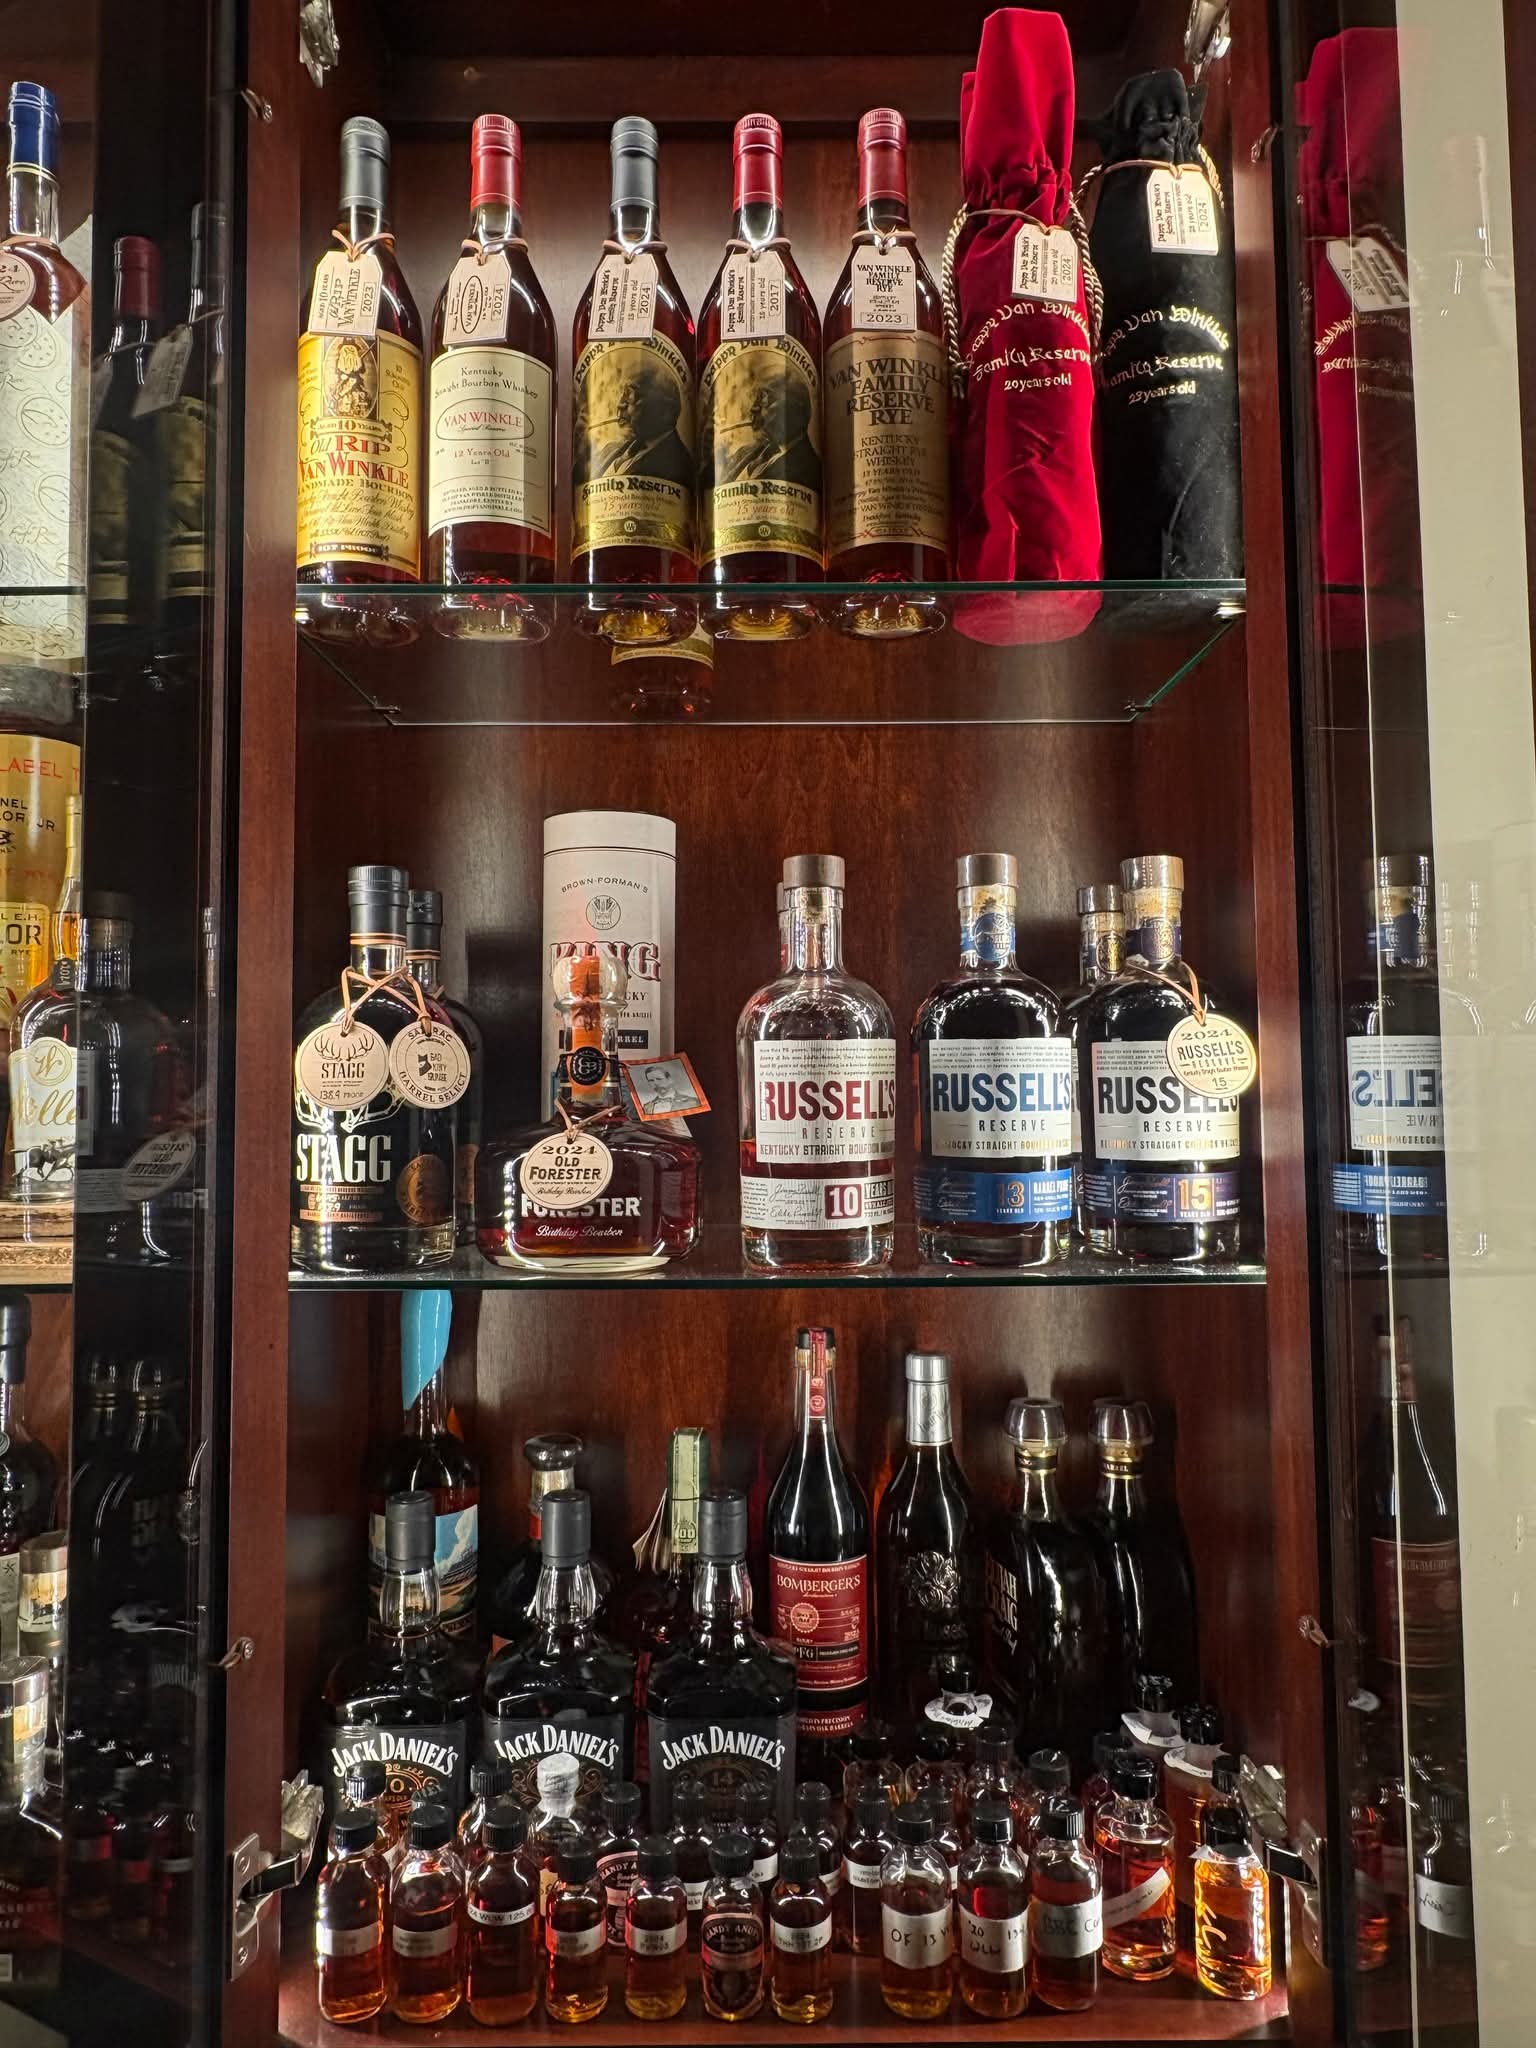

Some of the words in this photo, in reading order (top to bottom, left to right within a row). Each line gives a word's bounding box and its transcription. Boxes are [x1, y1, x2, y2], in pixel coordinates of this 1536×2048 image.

[876, 265, 912, 273] WINKLE
[363, 286, 379, 313] 2023
[493, 288, 505, 316] 2024
[640, 287, 651, 315] 2024
[770, 284, 780, 312] 2017
[867, 314, 903, 323] 2023
[997, 302, 1035, 320] Van
[461, 366, 503, 377] Kentucky
[1154, 354, 1224, 377] Reserve
[461, 377, 500, 388] Bourbon
[851, 375, 928, 395] FAMILY
[847, 391, 935, 416] RESERVE
[444, 412, 467, 427] VAN
[469, 411, 524, 427] WINKLE
[869, 409, 913, 426] RYE
[335, 435, 391, 456] RIP
[466, 448, 493, 456] Years
[494, 448, 511, 458] Old
[326, 452, 409, 491] WINKLE
[582, 479, 625, 501] Family
[627, 477, 681, 500] Reserve
[760, 481, 812, 505] Reserve
[1181, 1029, 1232, 1041] 2024
[1177, 1041, 1244, 1061] RUSSELL'S
[321, 1062, 365, 1079] STAGG
[400, 1071, 436, 1103] BARREL
[438, 1072, 467, 1102] SELECT
[932, 1072, 1071, 1113] RUSSELL'S
[1212, 1078, 1228, 1088] 15
[760, 1080, 896, 1121] RUSSELL'S
[802, 1126, 876, 1139] RESERVE
[978, 1119, 1047, 1132] RESERVE
[1143, 1121, 1212, 1133] RESERVE
[541, 1146, 595, 1154] 2024
[760, 1144, 800, 1156] KENTUCKY
[803, 1144, 845, 1156] STRAIGHT
[975, 1140, 1018, 1151] STRAIGHT
[1139, 1140, 1181, 1150] STRAIGHT
[297, 1132, 392, 1183] STAGG
[554, 1156, 579, 1167] OLD
[528, 1168, 600, 1181] FORESTER
[534, 1187, 564, 1198] Birthday
[565, 1186, 592, 1196] Bourbon
[996, 1181, 1025, 1208] 13
[1177, 1178, 1212, 1210] 15
[829, 1187, 860, 1217] 10
[535, 1224, 578, 1241] Birthday
[580, 1224, 625, 1238] Bourbon
[777, 1575, 861, 1594] BOMBERGER'S
[331, 1740, 381, 1777] JACK
[380, 1732, 459, 1777] DANIEL'S
[494, 1731, 543, 1765] JACK
[542, 1724, 620, 1771] DANIEL'S
[660, 1733, 709, 1770] JACK
[709, 1726, 786, 1771] DANIEL'S
